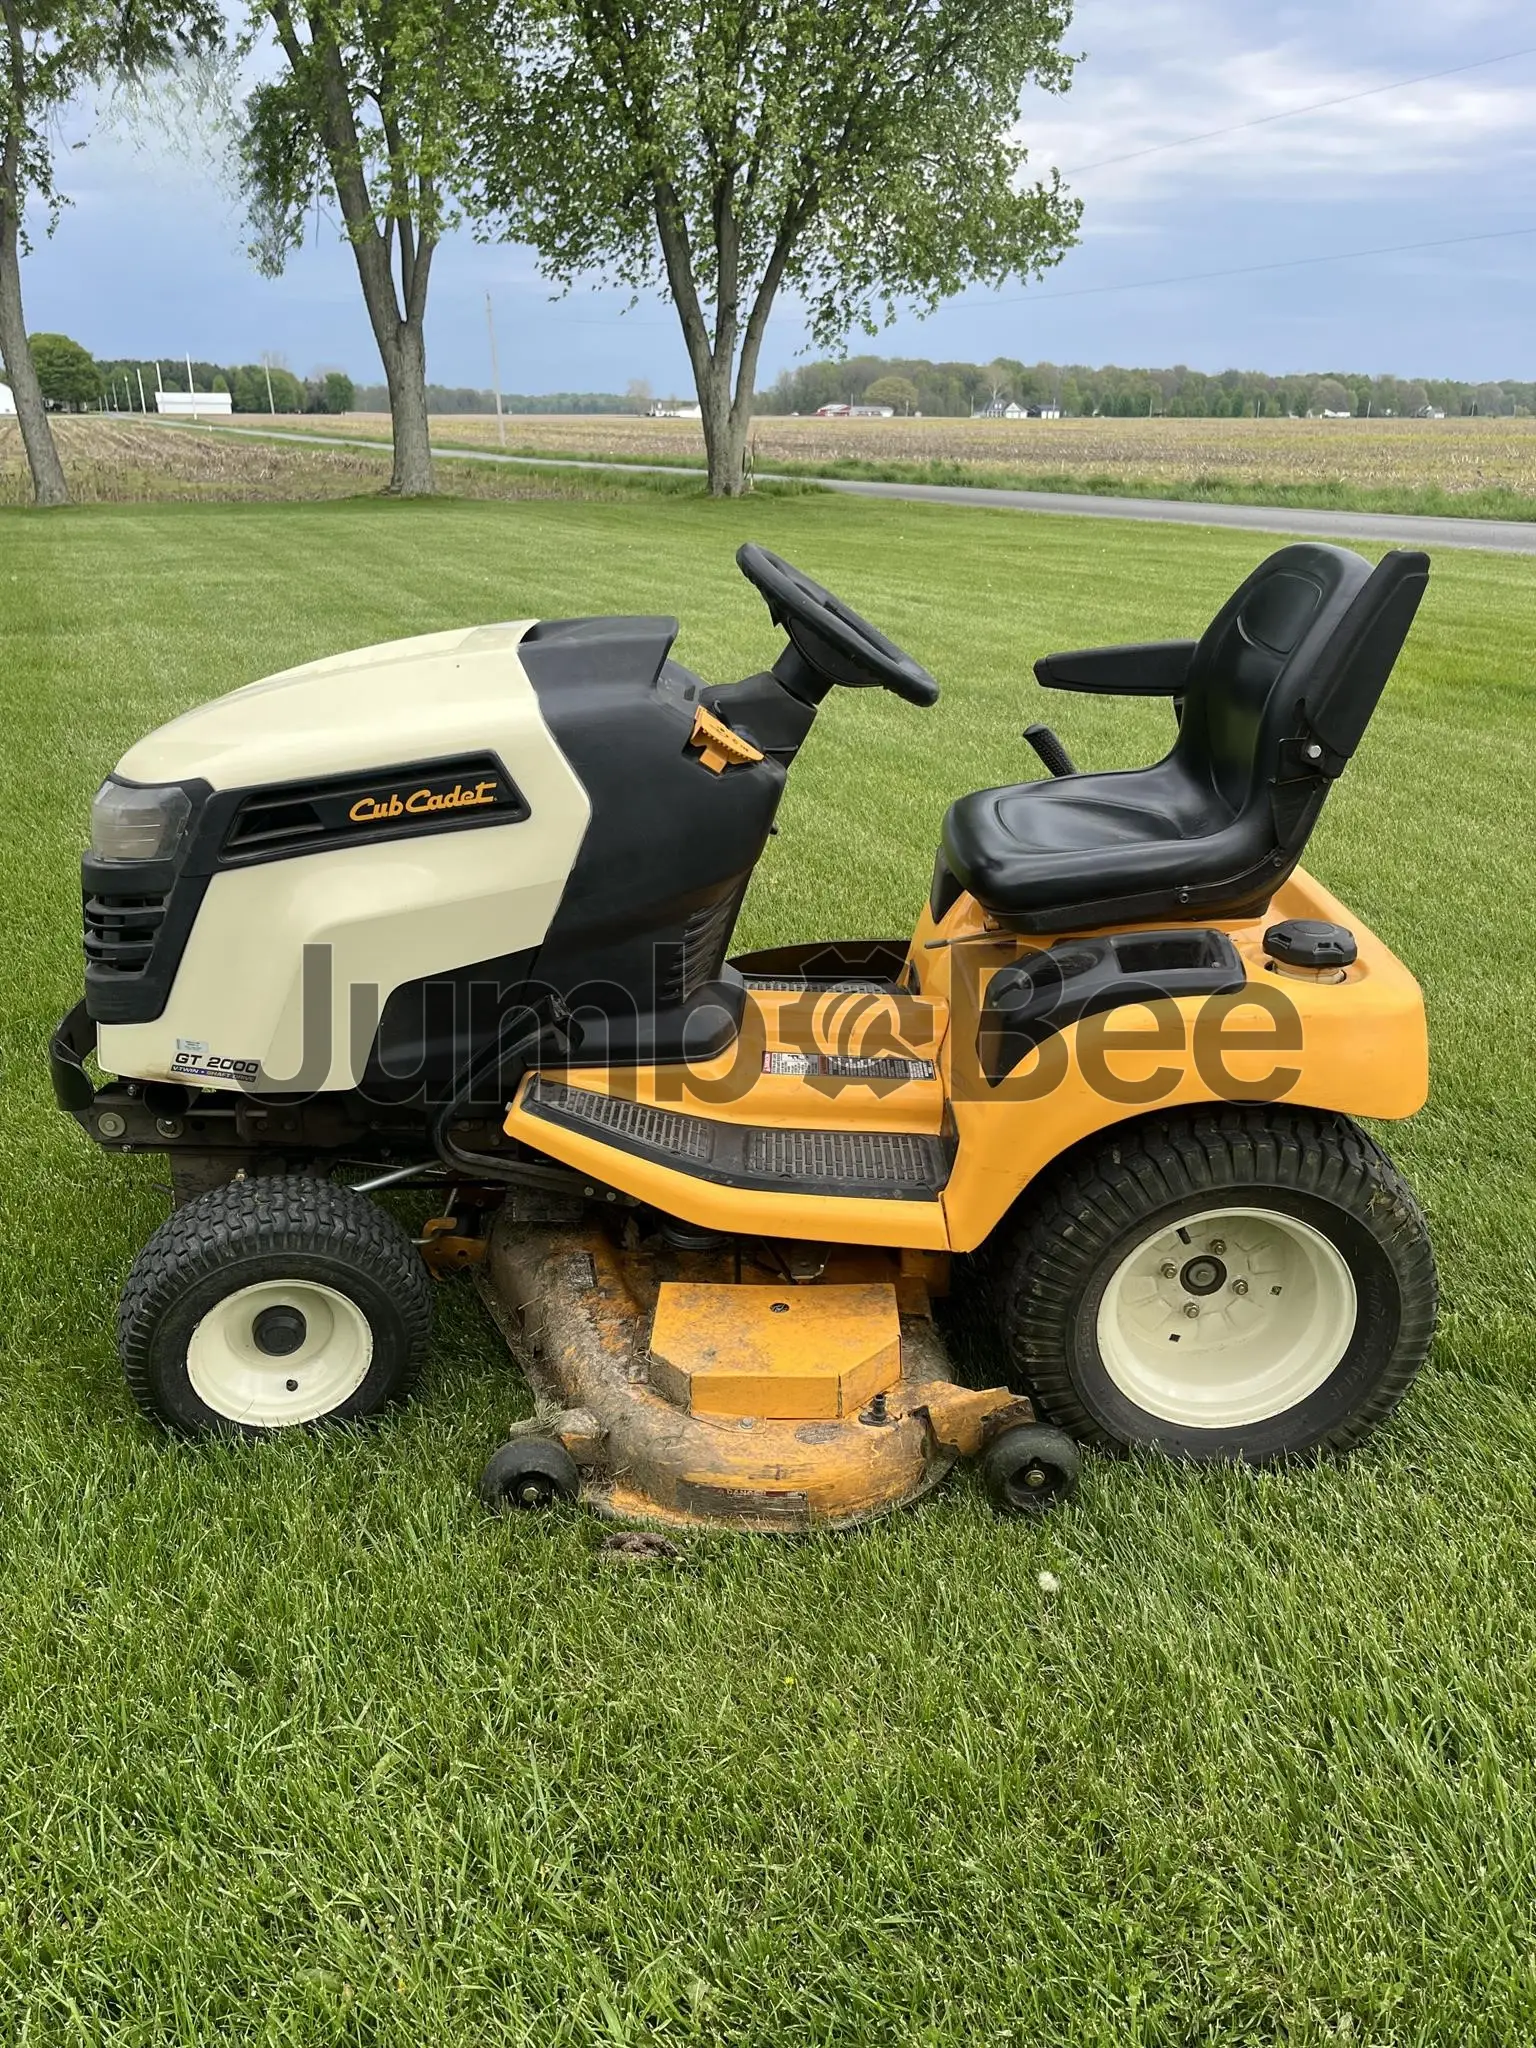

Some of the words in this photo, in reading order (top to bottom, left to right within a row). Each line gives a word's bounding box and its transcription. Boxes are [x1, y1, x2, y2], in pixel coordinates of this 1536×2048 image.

[349, 794, 404, 821] Cub
[405, 782, 497, 813] Cadet
[175, 1053, 202, 1066] GT
[206, 1057, 259, 1074] 2000
